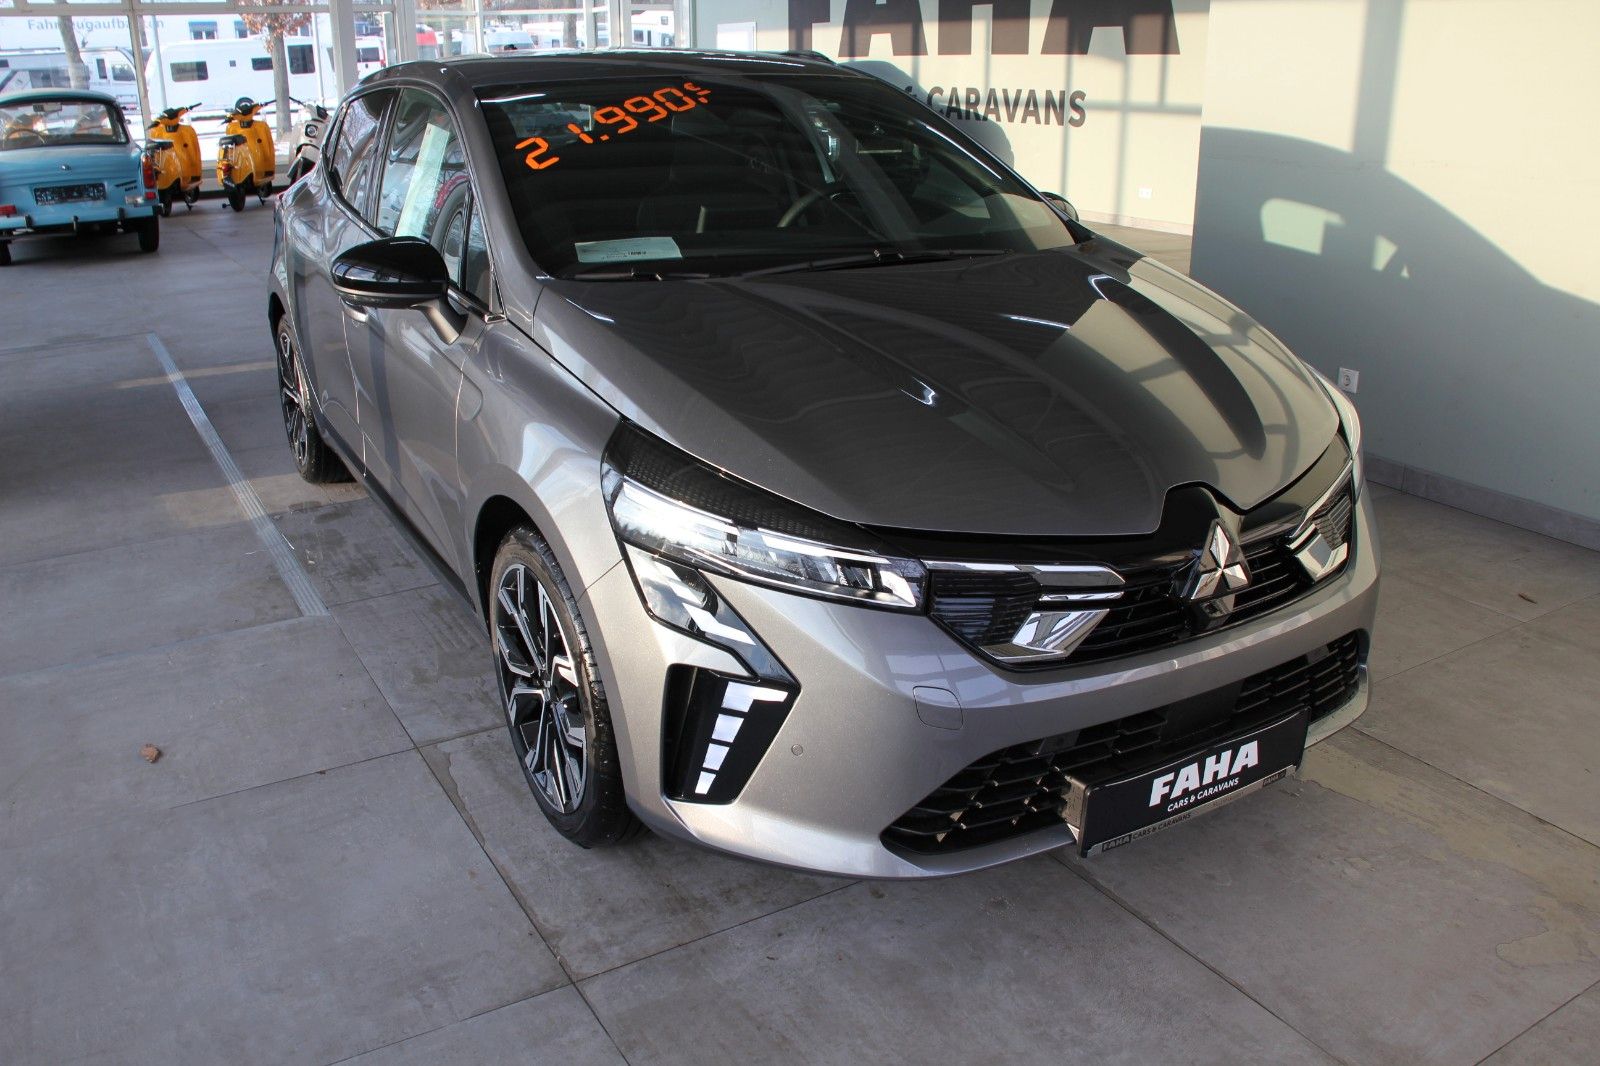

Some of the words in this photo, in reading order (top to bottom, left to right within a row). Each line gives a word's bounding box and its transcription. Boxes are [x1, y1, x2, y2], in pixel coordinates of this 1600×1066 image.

[927, 86, 1087, 127] CARAVANS
[1149, 740, 1259, 807] FAHA
[1167, 798, 1189, 812] CARS
[1189, 795, 1196, 803] &
[1197, 777, 1239, 800] CARAVANS
